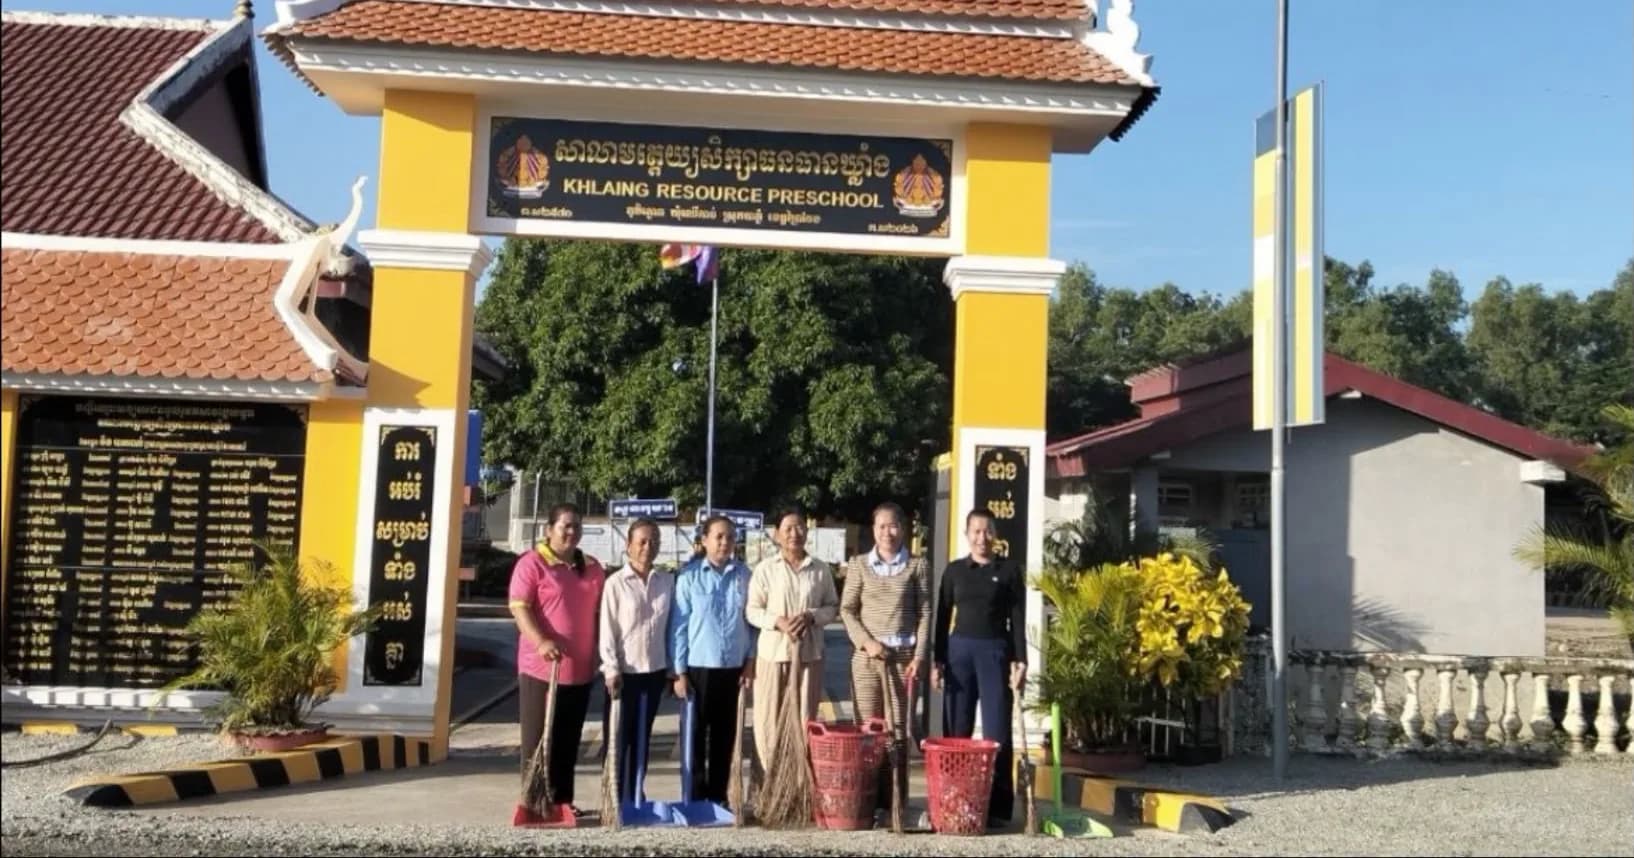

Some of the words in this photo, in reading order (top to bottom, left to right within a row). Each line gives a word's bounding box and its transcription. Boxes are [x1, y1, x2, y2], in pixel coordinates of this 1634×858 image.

[554, 136, 890, 186] សាលាមត្តេយ្យសិក្សាធនធានឃ្លាំង
[563, 178, 649, 198] KHLAING
[656, 183, 762, 203] RESOURCE
[767, 188, 884, 209] PRESCHOOL
[395, 441, 420, 461] ការ
[987, 452, 1017, 481] ទាំង
[389, 472, 422, 500] អប់រំ
[987, 490, 1015, 519] អស់
[376, 512, 430, 547] សម្រាប់
[384, 551, 416, 581] ទាំង
[382, 592, 412, 621] អស់
[385, 642, 404, 670] គ្នា
